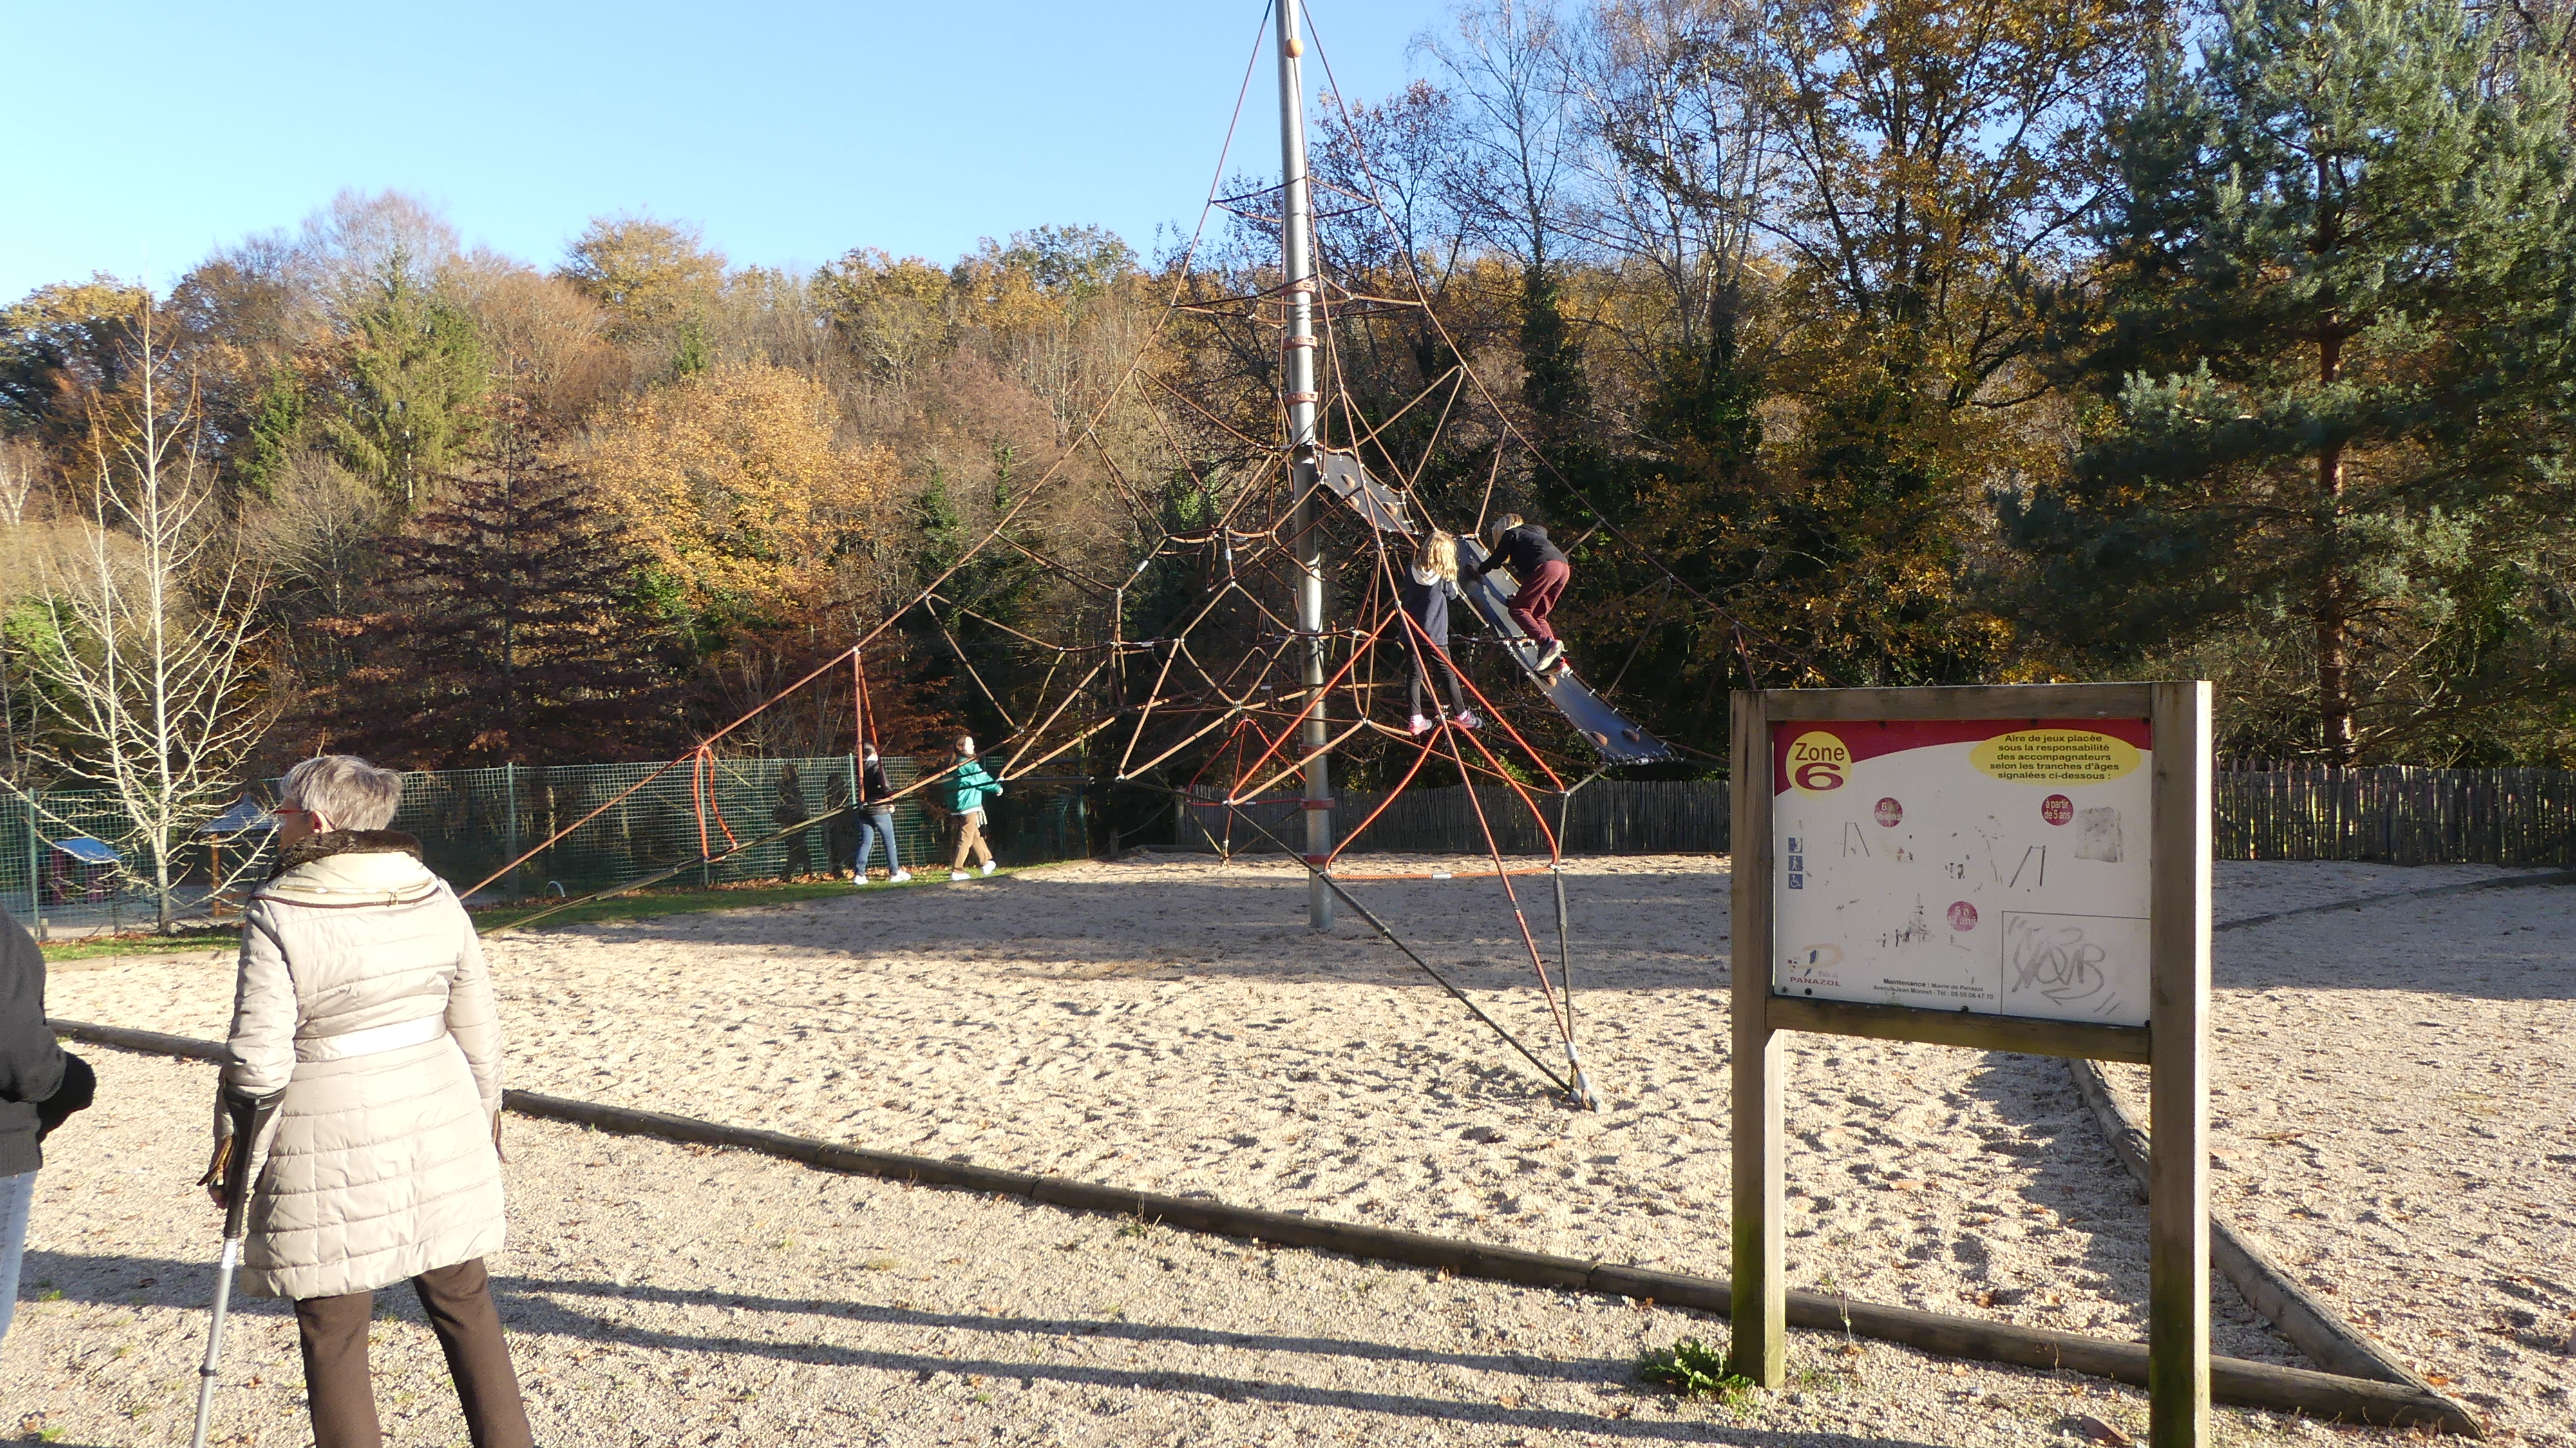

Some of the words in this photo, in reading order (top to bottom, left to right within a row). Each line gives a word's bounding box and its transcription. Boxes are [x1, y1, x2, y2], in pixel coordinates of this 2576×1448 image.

[2042, 734, 2065, 743] jeux
[2067, 735, 2102, 743] placée
[1794, 742, 1844, 761] Zone
[2036, 744, 2110, 752] responsabilité
[2018, 754, 2111, 762] accompagnateurs
[2084, 763, 2119, 772] d'âges
[1795, 762, 1844, 791] 6
[1998, 772, 2047, 780] signalées
[2050, 799, 2069, 810] partir
[2044, 809, 2052, 819] de
[2053, 809, 2058, 820] 5
[1790, 976, 1841, 987] PANAZOL
[1883, 978, 1926, 987] Maintenance
